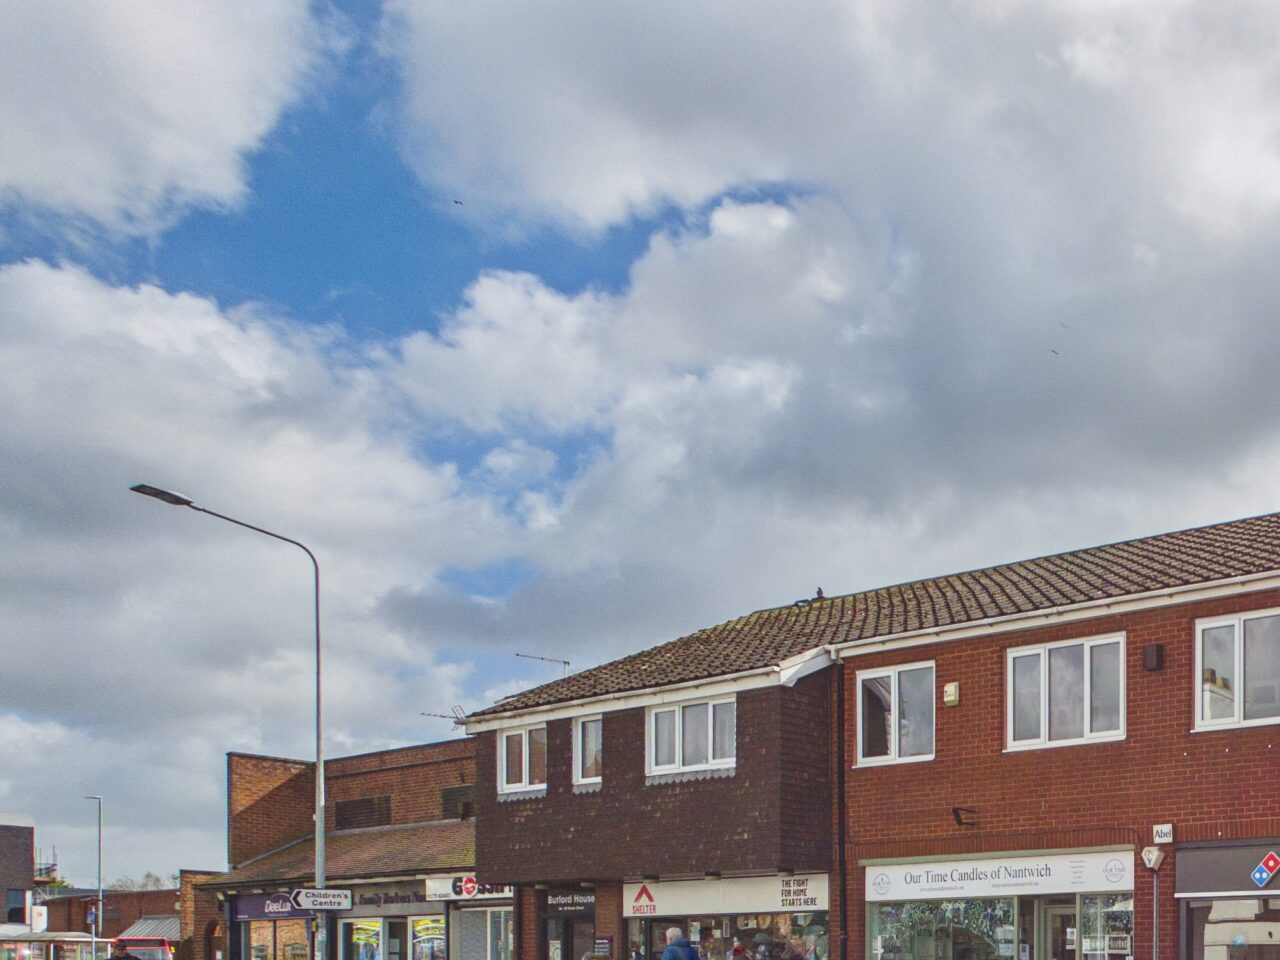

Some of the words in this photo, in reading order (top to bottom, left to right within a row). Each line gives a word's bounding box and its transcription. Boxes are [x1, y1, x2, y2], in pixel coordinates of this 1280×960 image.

[1154, 829, 1172, 838] Abel
[904, 872, 922, 884] Our
[924, 870, 948, 884] Time
[950, 867, 988, 882] Candles
[990, 866, 1003, 880] of
[1003, 863, 1052, 879] Nantwich
[782, 879, 792, 888] THE
[792, 878, 808, 888] FIGHT
[304, 891, 349, 899] Children's
[781, 889, 791, 897] FOR
[793, 888, 807, 897] HOME
[547, 894, 572, 905] Burford
[573, 894, 596, 904] House
[781, 898, 802, 907] STARTS
[802, 897, 818, 906] HERE
[632, 904, 657, 914] SHELTER
